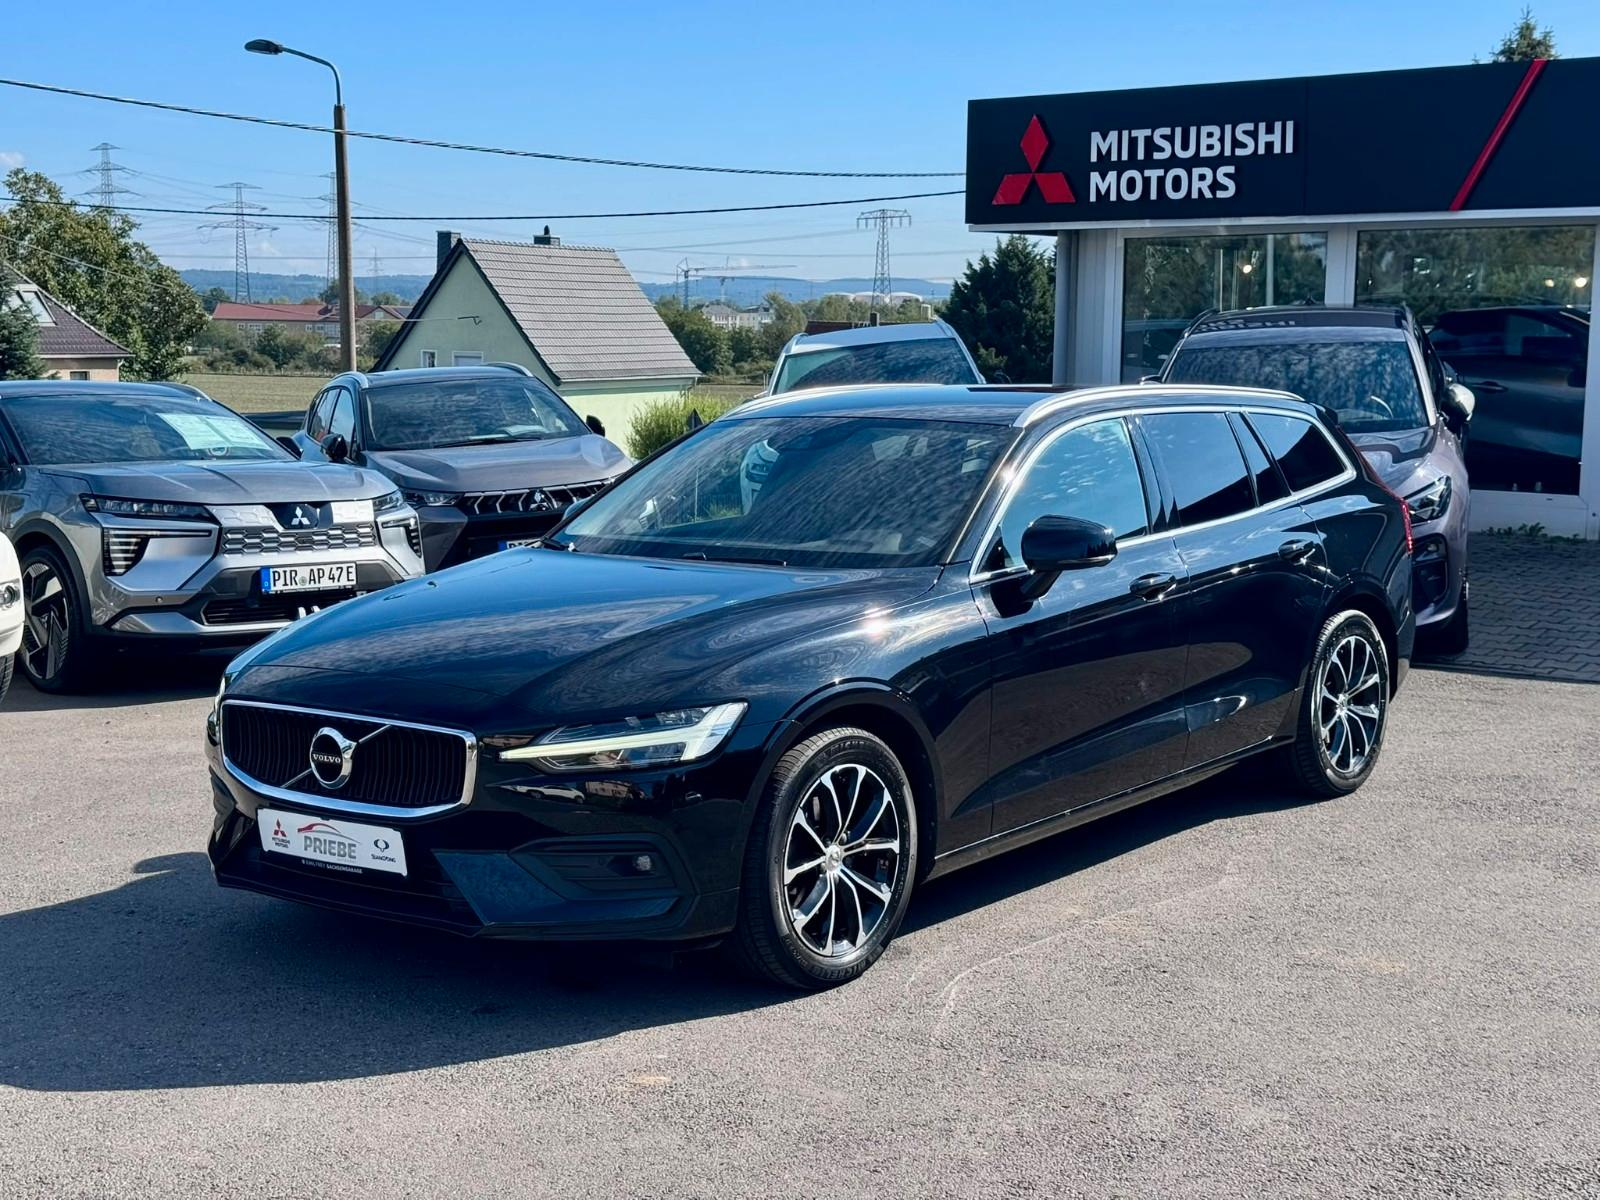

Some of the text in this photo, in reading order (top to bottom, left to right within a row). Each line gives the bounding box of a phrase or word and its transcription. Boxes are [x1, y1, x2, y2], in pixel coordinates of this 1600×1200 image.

[1090, 120, 1295, 163] MITSUBISHI
[1089, 166, 1236, 202] MOTORS
[272, 569, 298, 587] PIR
[309, 568, 325, 585] AP
[312, 753, 342, 764] VOLVO
[303, 835, 357, 859] PRIEBE
